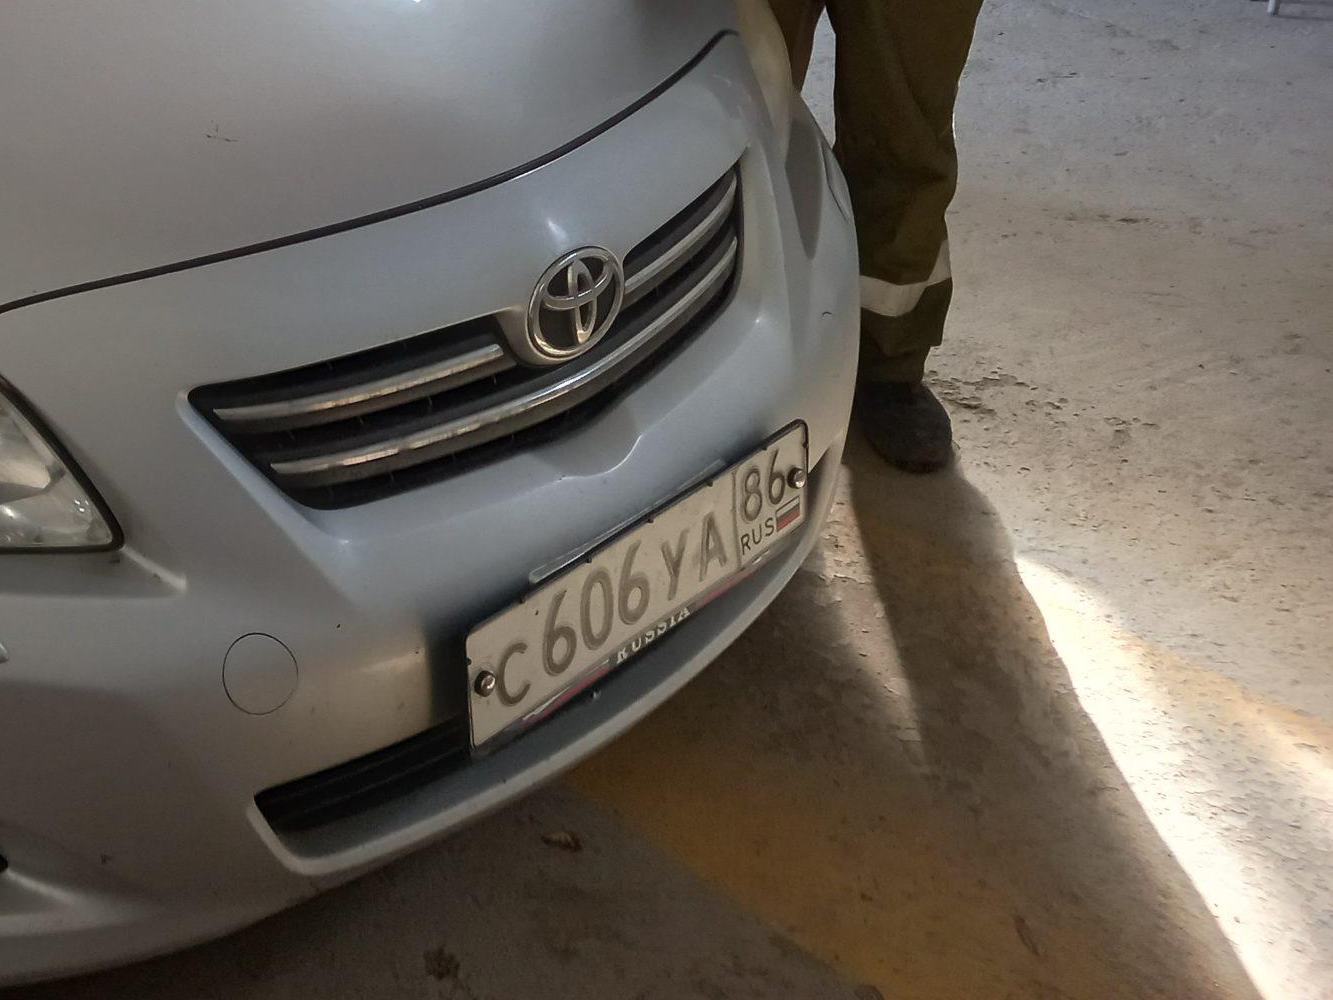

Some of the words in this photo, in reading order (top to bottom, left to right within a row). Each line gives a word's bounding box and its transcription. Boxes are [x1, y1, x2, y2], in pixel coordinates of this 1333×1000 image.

[496, 511, 728, 707] С606УА
[743, 448, 786, 523] 86
[740, 517, 775, 555] RUS
